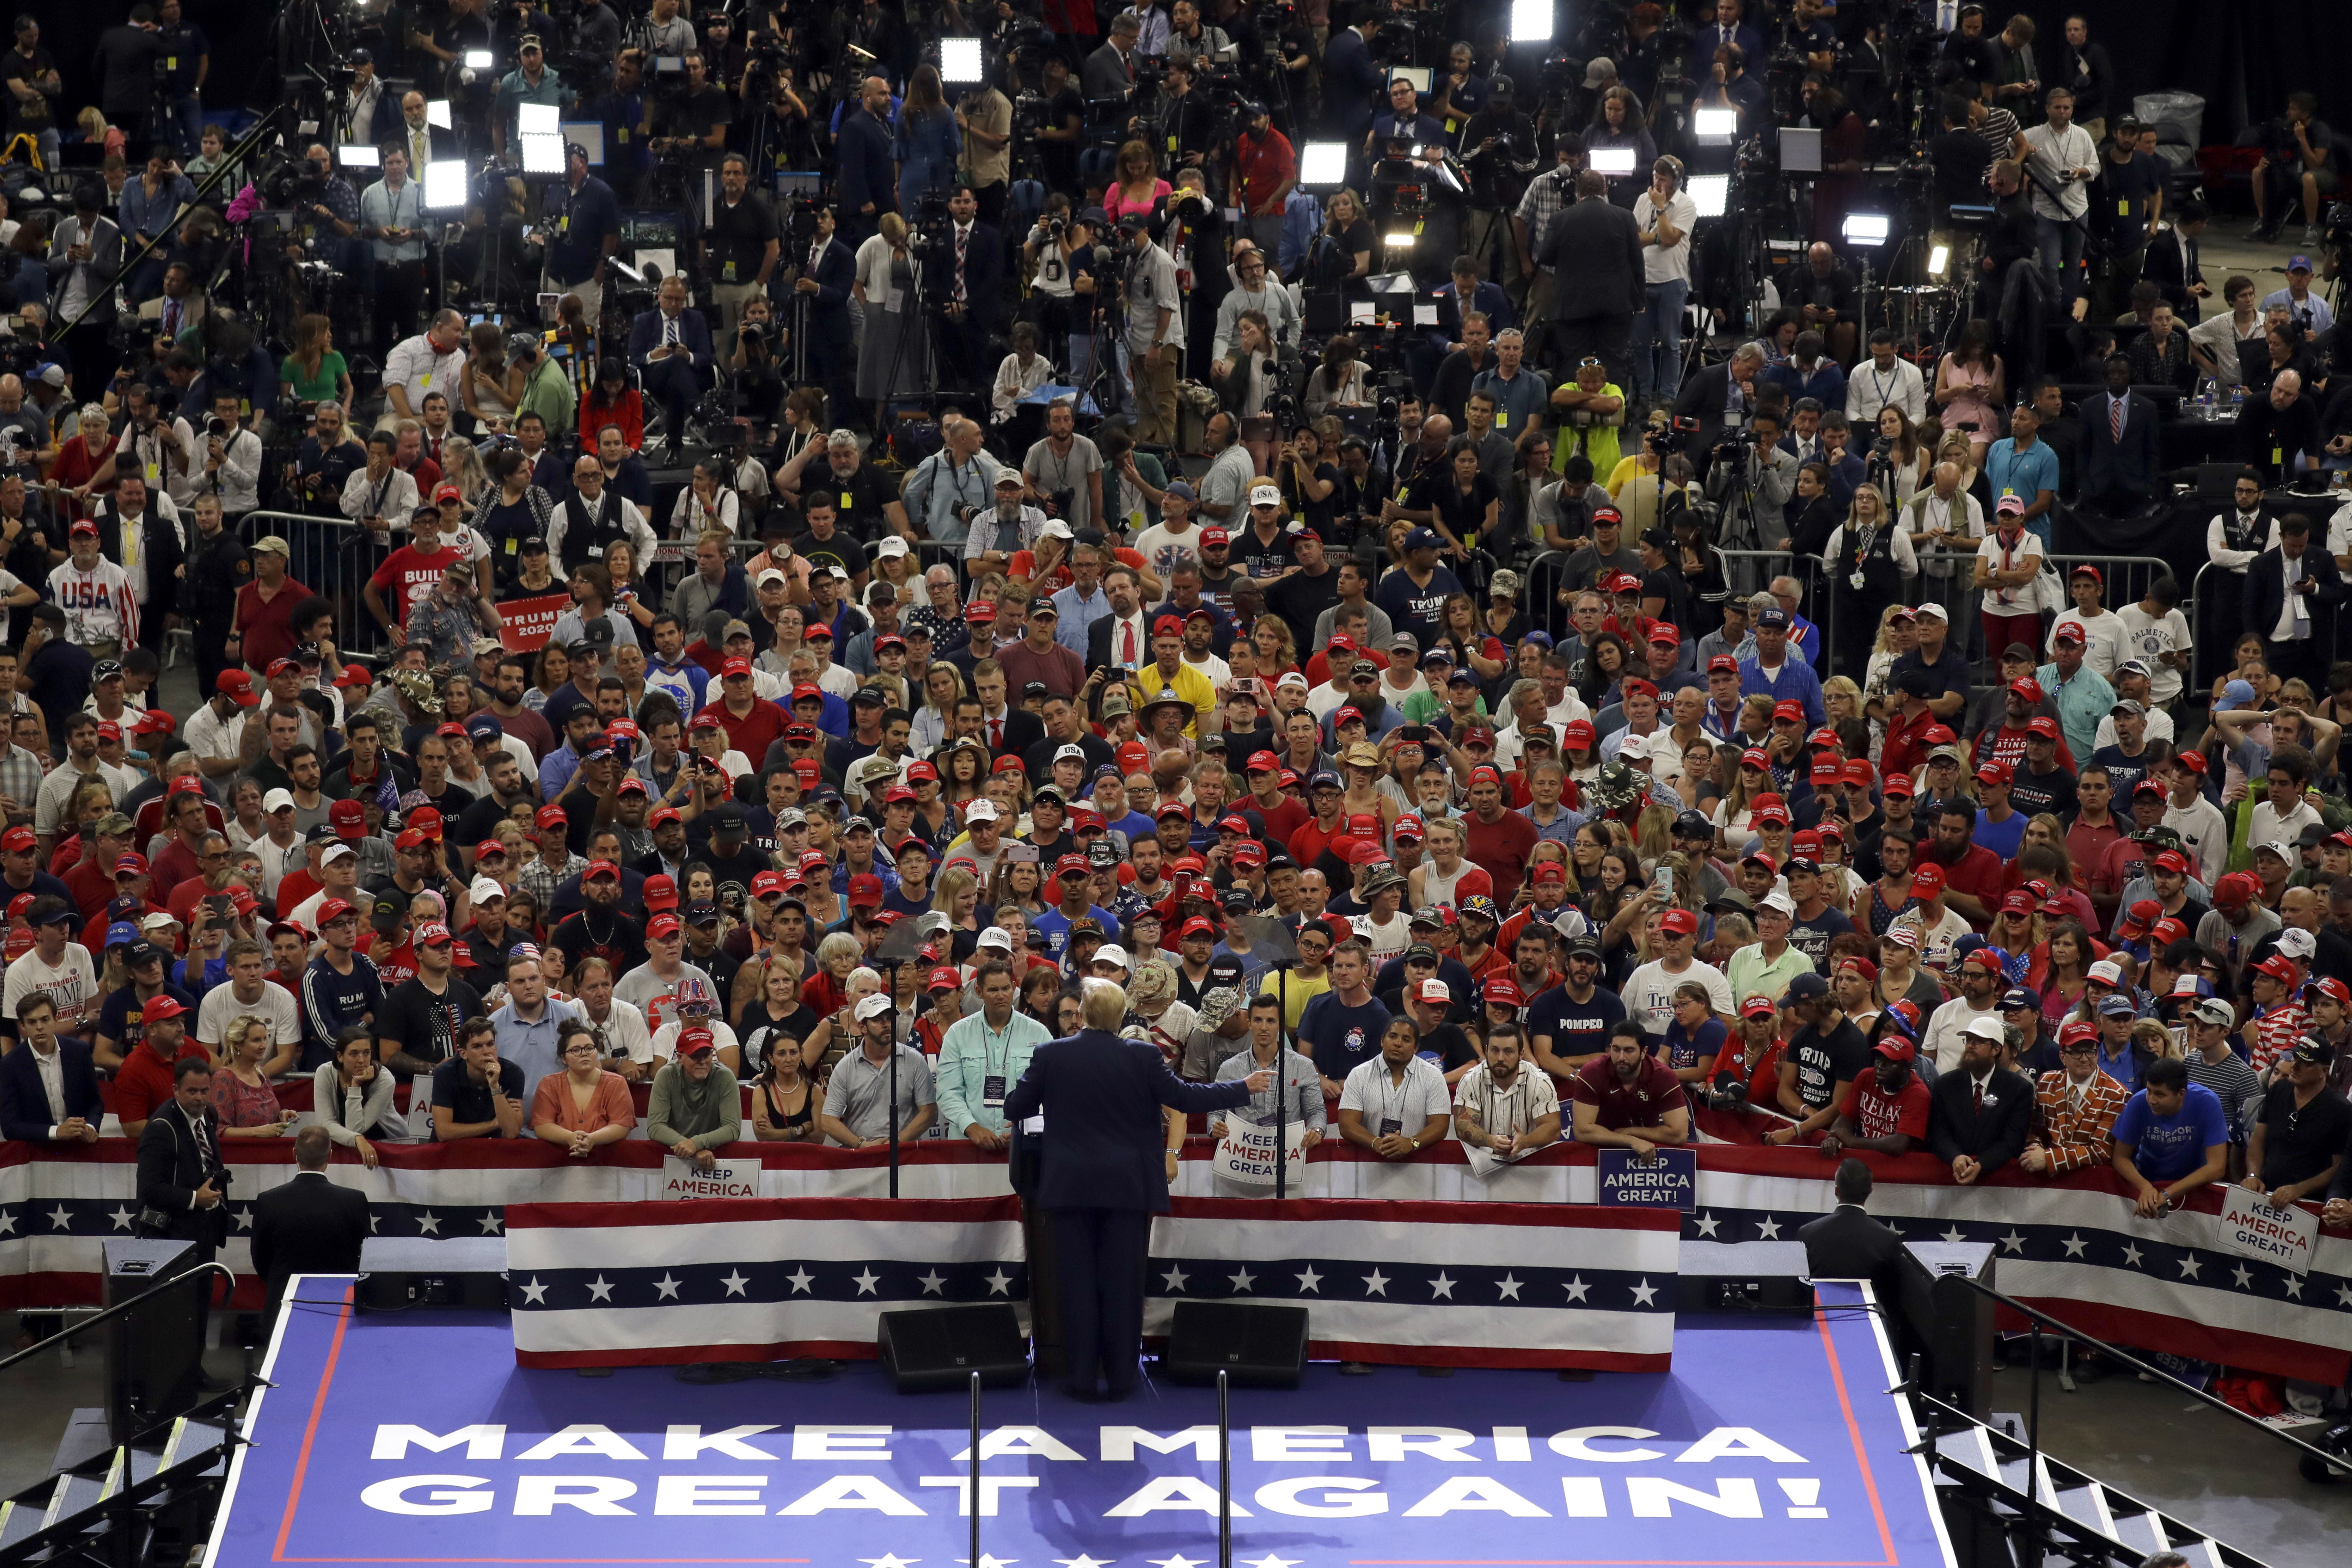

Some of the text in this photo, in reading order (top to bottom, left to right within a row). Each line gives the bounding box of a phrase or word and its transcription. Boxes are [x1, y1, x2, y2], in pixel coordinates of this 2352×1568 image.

[405, 570, 442, 583] BUIL
[62, 582, 112, 609] USA
[1409, 595, 1448, 610] TRUM
[503, 609, 568, 627] TRUMP
[518, 624, 555, 636] 2020
[2018, 680, 2033, 688] AMERICA
[1064, 747, 1081, 756] USA
[2140, 780, 2157, 788] USA
[2014, 787, 2052, 804] TRUMP
[757, 838, 781, 849] TRU
[1372, 862, 1391, 870] Trump
[1190, 884, 1204, 893] SA
[426, 924, 448, 935] FNN
[1073, 920, 1092, 930] USA
[1351, 920, 1368, 931] USA
[988, 932, 1008, 942] Trump
[2282, 931, 2302, 944] TRUMP
[1802, 940, 1824, 953] Rock
[378, 966, 413, 978] CKET MAN
[1648, 993, 1673, 1007] Tru
[449, 1002, 461, 1035] COUNT
[1560, 1019, 1603, 1029] POMPEO
[1800, 1047, 1831, 1070] TRUMP
[1803, 1085, 1830, 1096] LIBERALS
[1803, 1093, 1820, 1102] AGAIN
[1222, 1141, 1301, 1161] AMERIA
[1626, 1158, 1668, 1169] KEEP
[690, 1168, 733, 1180] KEEP
[1604, 1173, 1690, 1188] AMERICA
[668, 1180, 753, 1196] AMERICA
[1617, 1190, 1678, 1202] GREAT!
[2251, 1204, 2293, 1223] KEEP
[2226, 1211, 2307, 1250] AMERICA
[2236, 1231, 2293, 1259] GREAT!
[370, 1424, 1811, 1464] MAKE AMERICA
[359, 1474, 1830, 1520] GREAT AGAIN!
